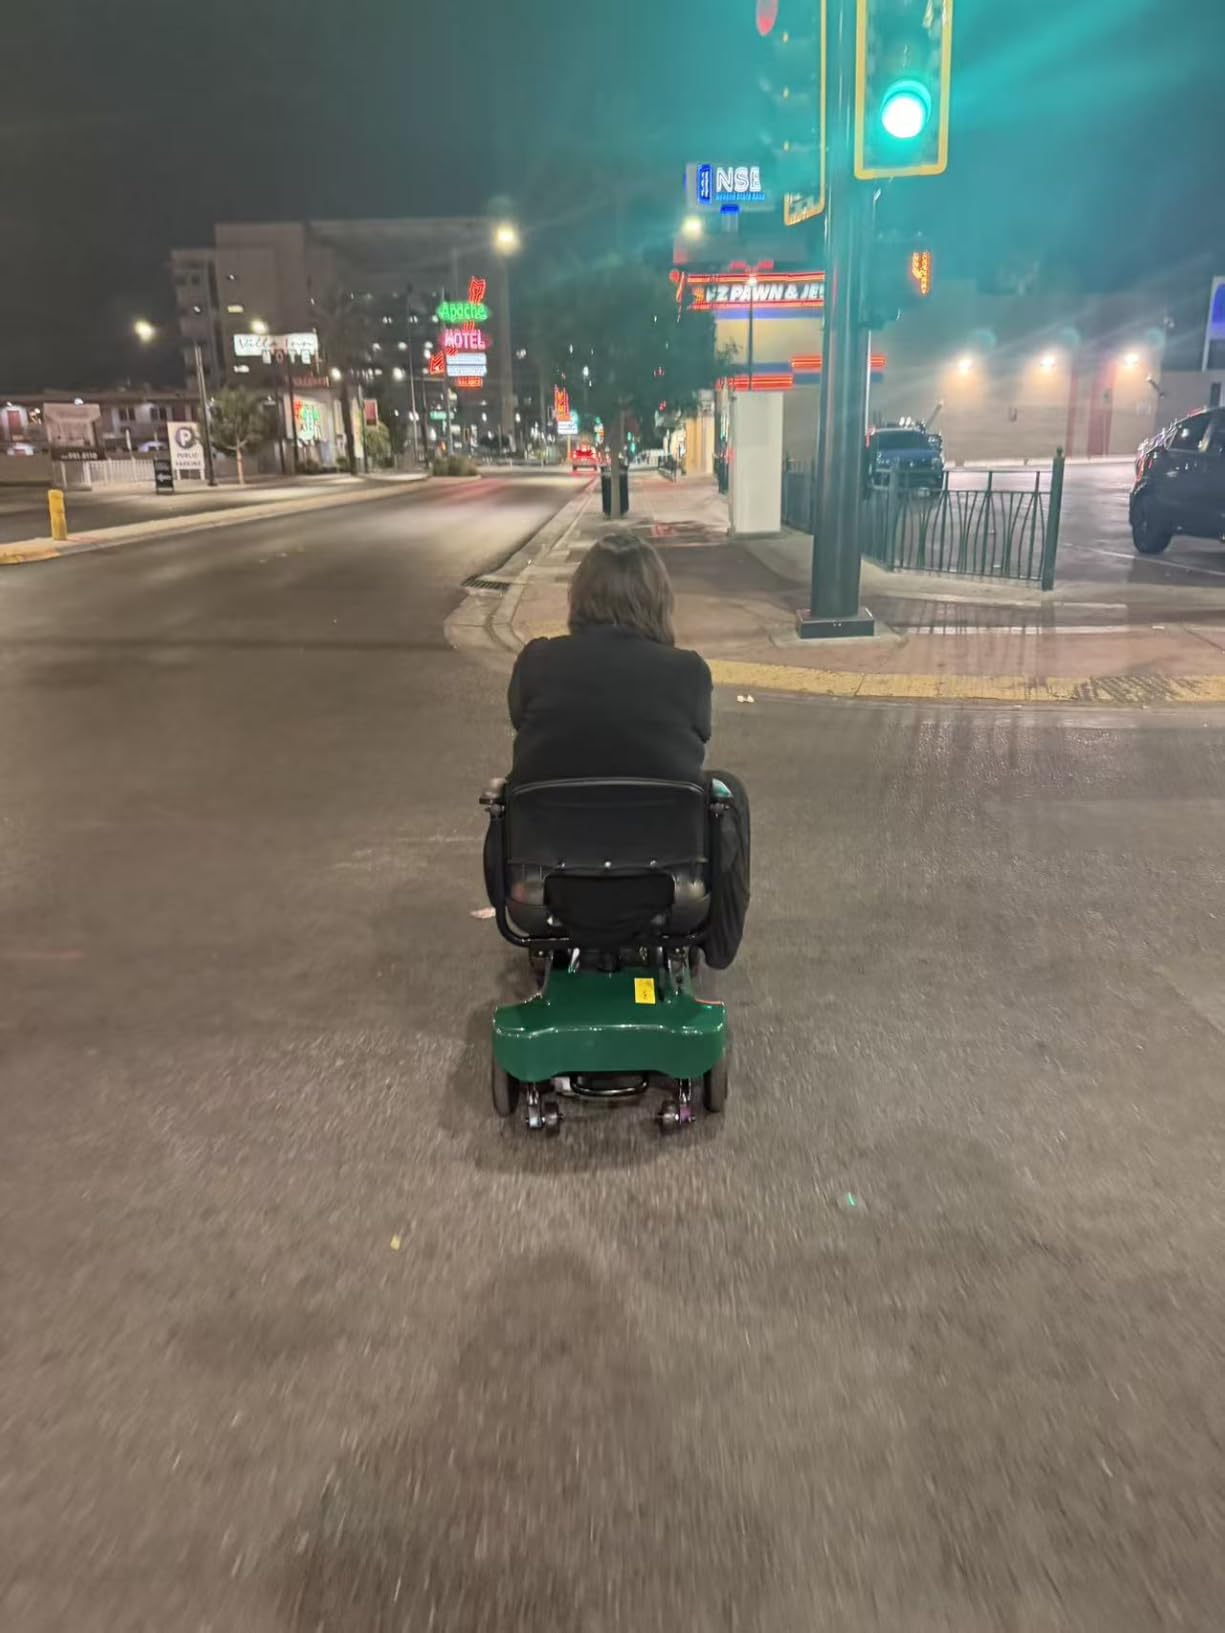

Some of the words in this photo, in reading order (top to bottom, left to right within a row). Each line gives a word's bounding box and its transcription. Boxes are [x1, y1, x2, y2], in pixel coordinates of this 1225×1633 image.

[730, 283, 783, 302] PAWN
[784, 283, 799, 301] &
[444, 329, 486, 349] MOTEL
[180, 429, 192, 447] P
